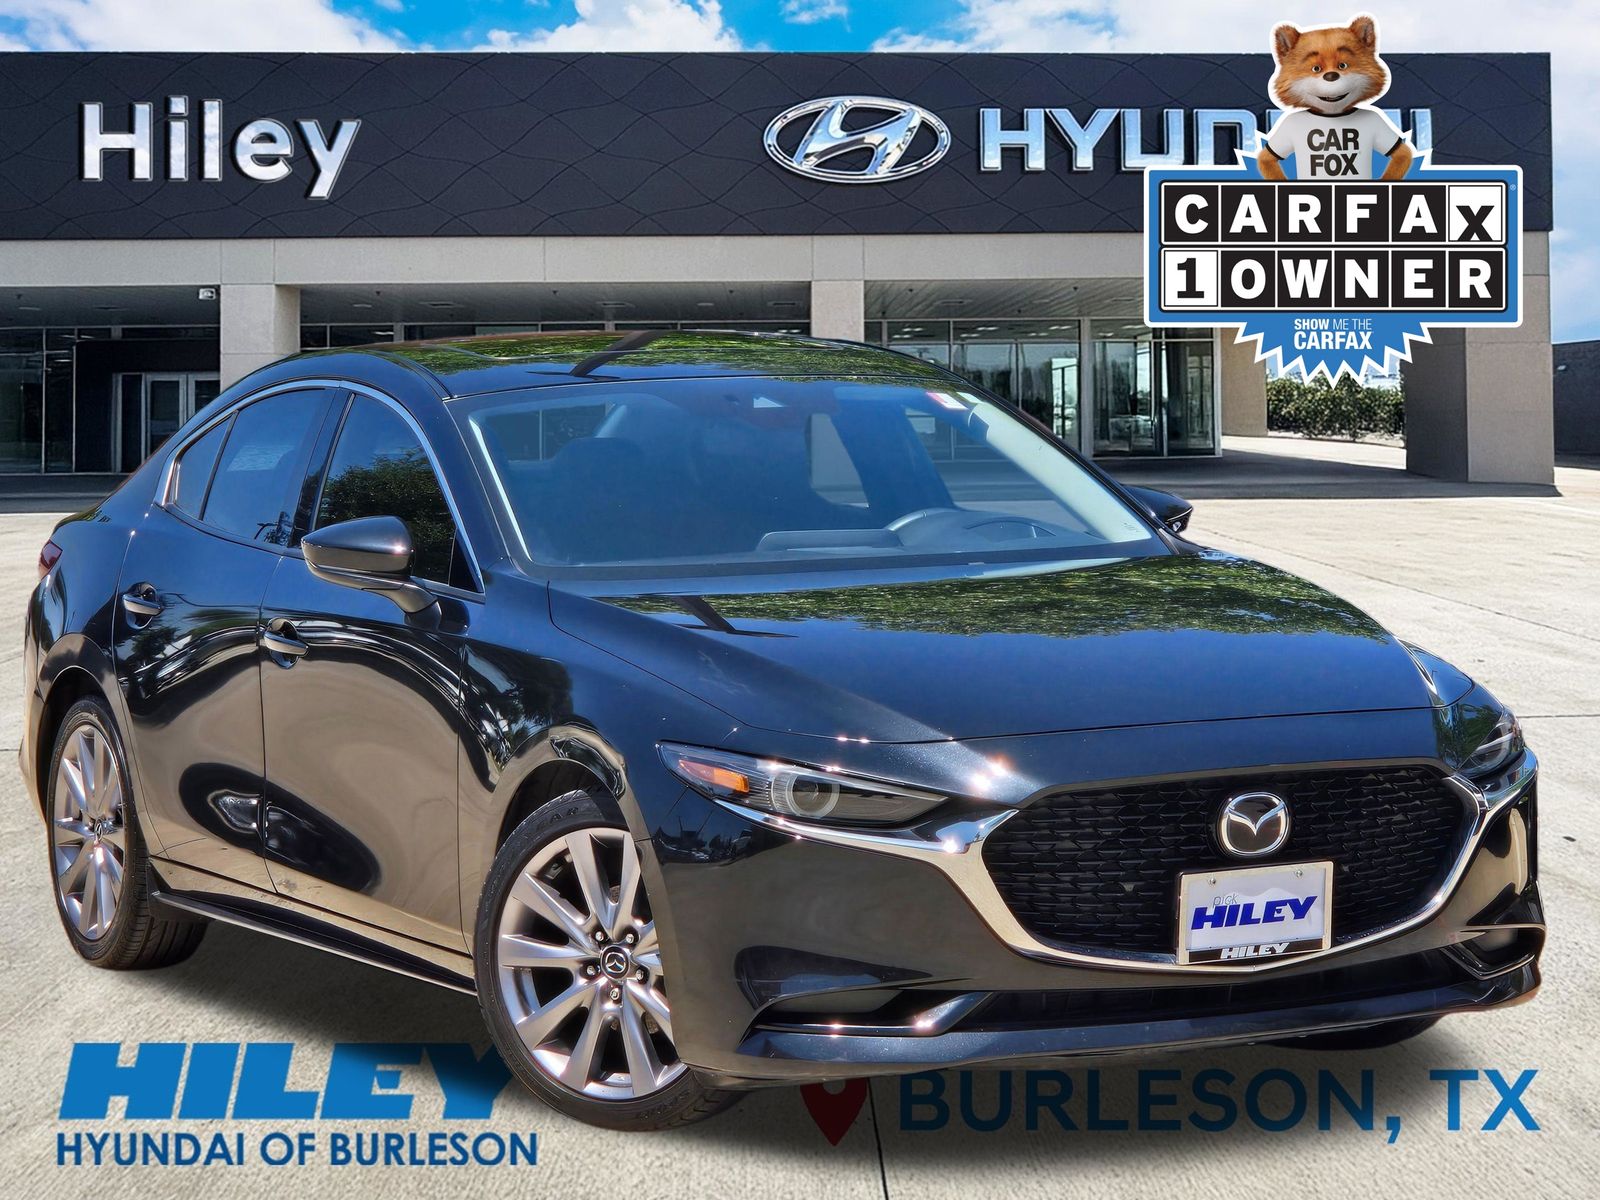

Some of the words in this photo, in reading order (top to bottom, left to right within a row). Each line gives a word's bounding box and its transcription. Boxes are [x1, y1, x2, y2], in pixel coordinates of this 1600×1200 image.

[80, 94, 362, 200] Hiley
[979, 108, 1433, 172] HYUNI
[1191, 896, 1318, 930] HILEY
[1220, 942, 1290, 960] HILEY
